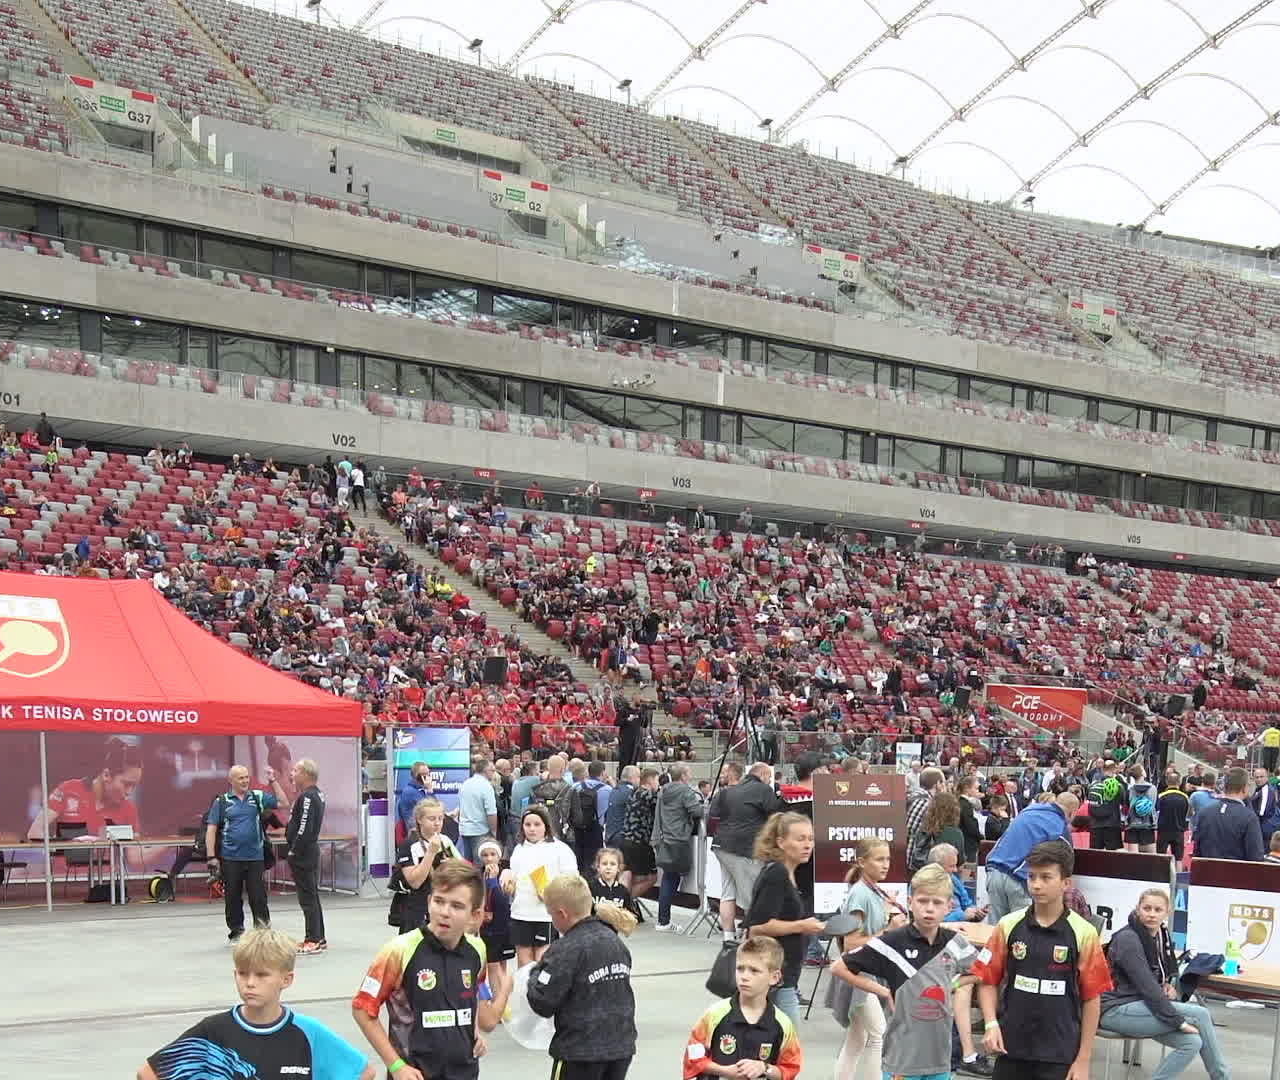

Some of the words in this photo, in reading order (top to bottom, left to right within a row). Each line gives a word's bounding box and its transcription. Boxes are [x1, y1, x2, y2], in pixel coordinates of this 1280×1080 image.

[127, 110, 152, 125] G37
[528, 201, 542, 212] G2
[332, 432, 357, 448] V02
[672, 477, 692, 489] V03
[919, 508, 936, 519] V04
[1127, 535, 1141, 544] V05
[1011, 694, 1041, 710] PGE
[22, 705, 85, 721] TENISA
[92, 707, 199, 724] STOŁOWEGO
[828, 826, 894, 842] PSYCHOLOG
